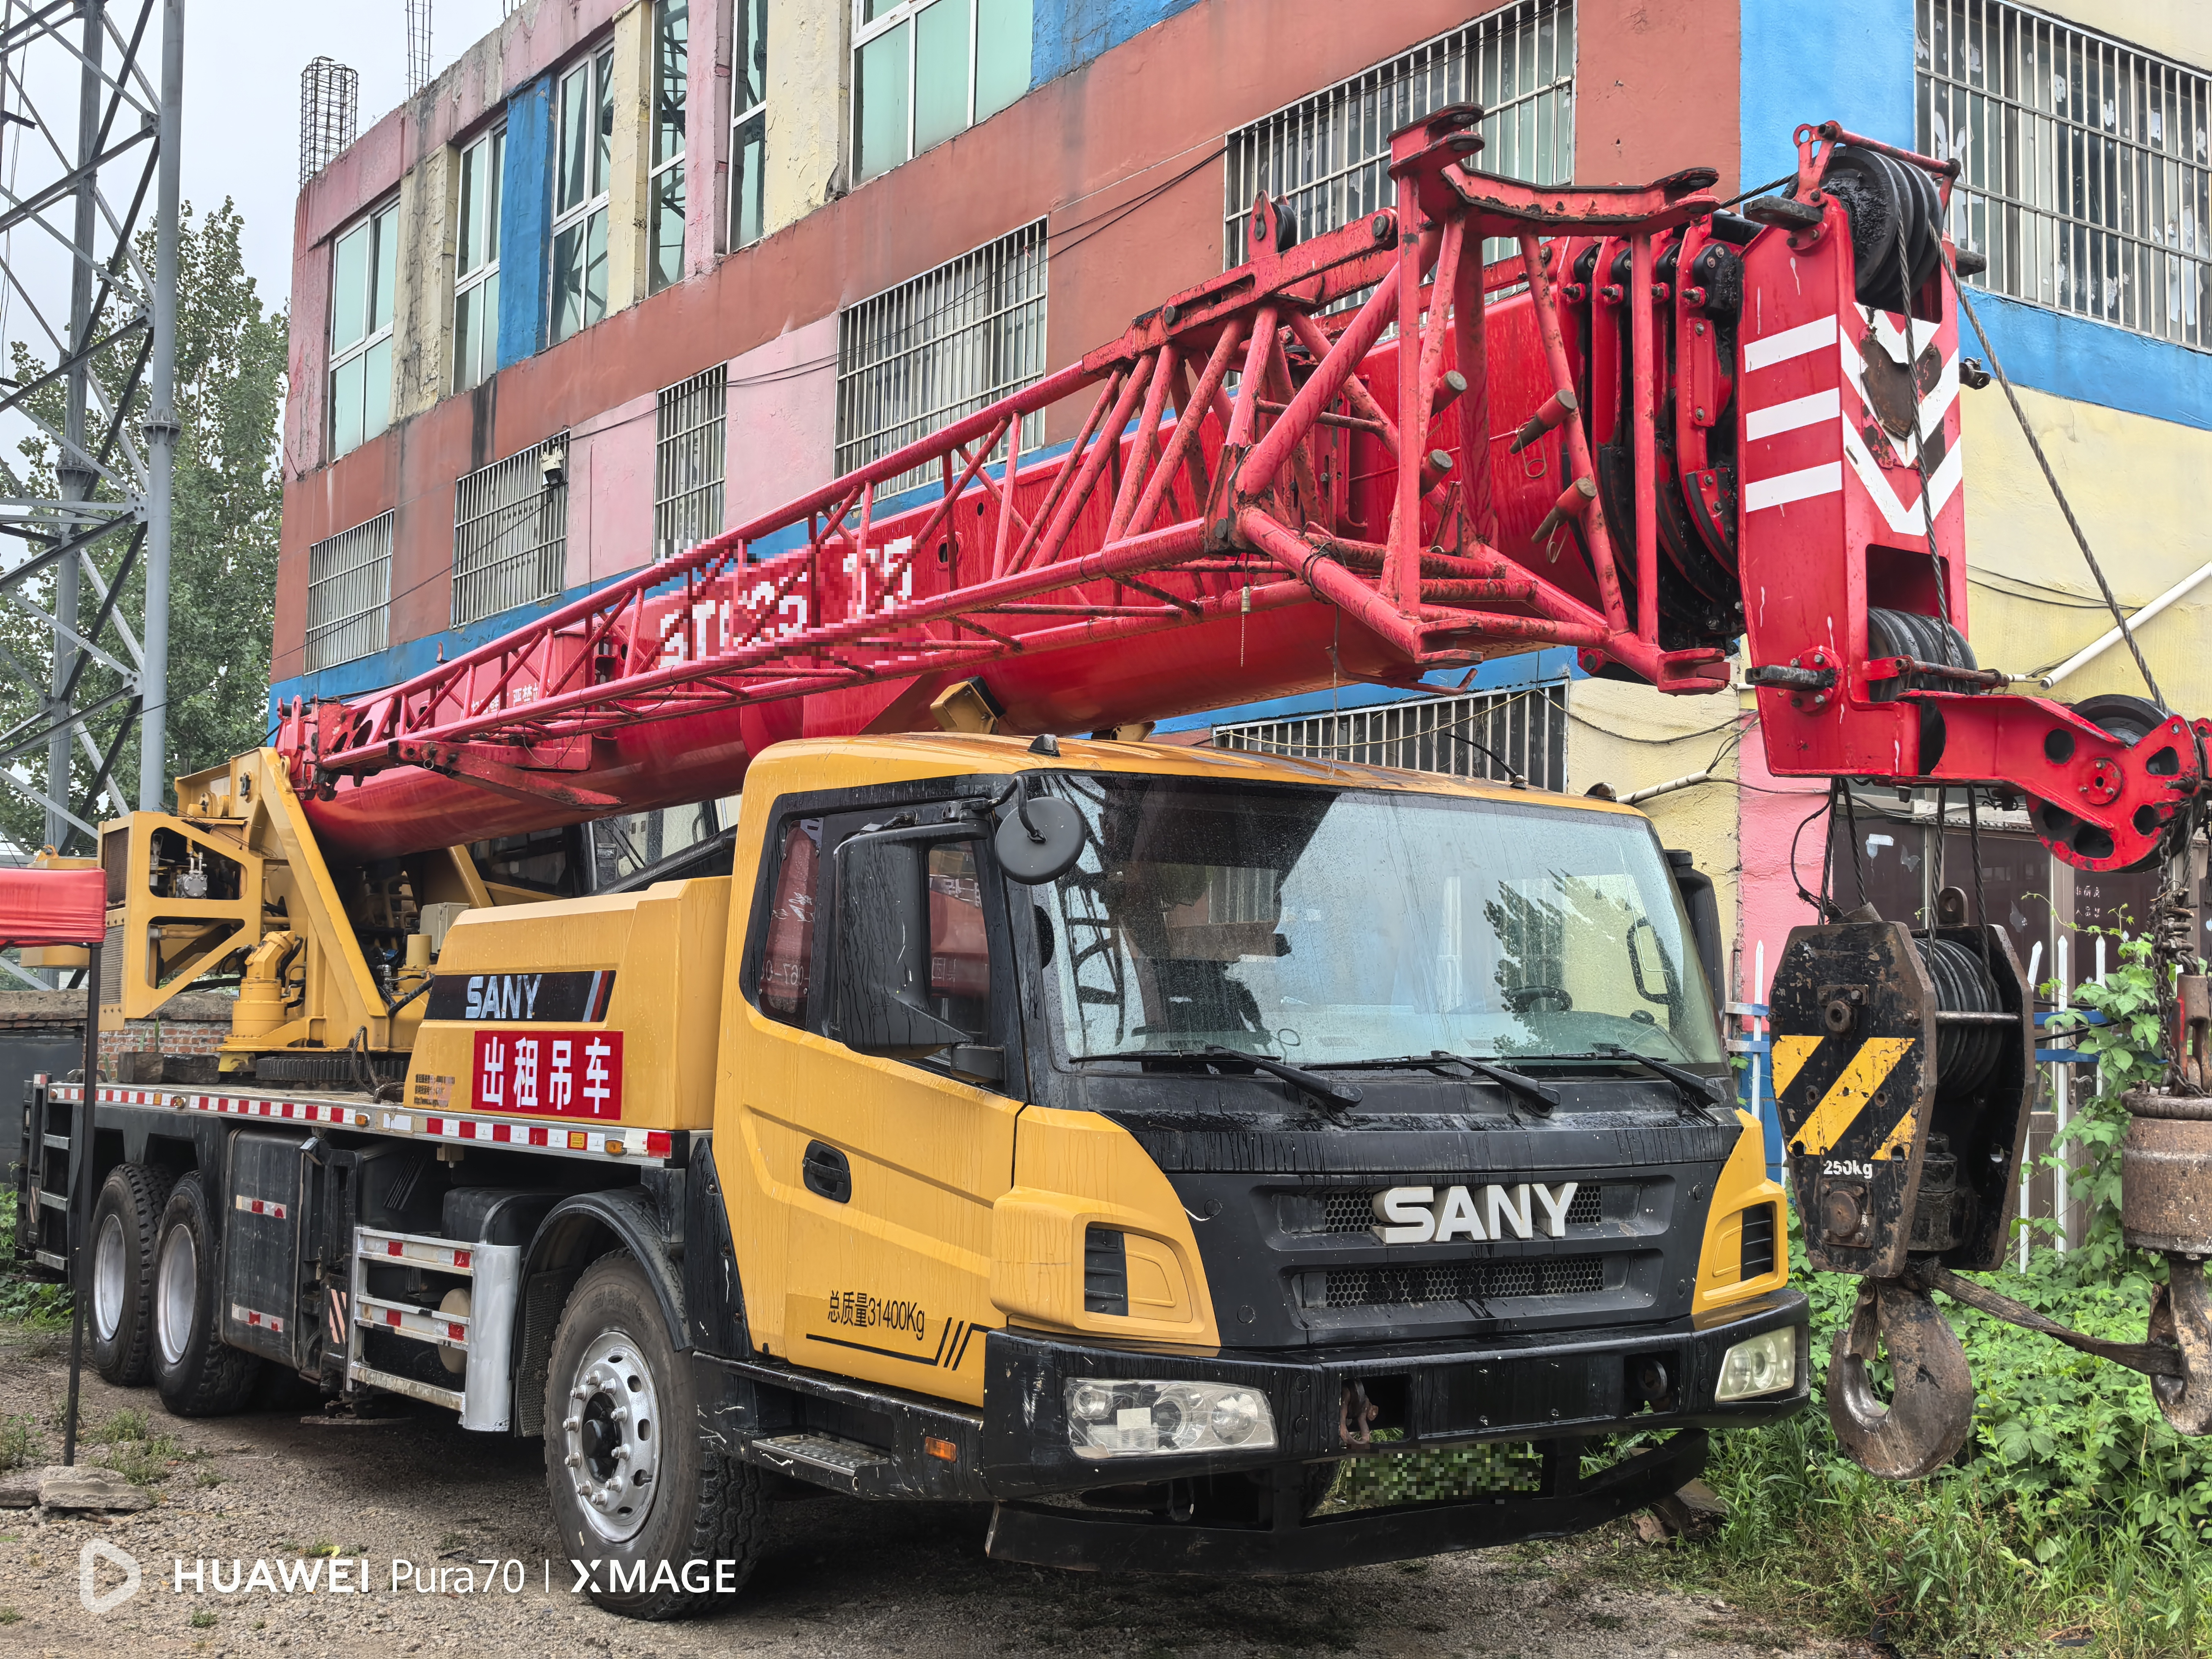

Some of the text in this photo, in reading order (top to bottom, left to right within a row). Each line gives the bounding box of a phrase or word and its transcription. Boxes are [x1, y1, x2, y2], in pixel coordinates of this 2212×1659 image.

[465, 975, 542, 1019] SANY
[482, 1036, 611, 1114] 出租吊车
[1823, 1160, 1873, 1179] 250kg
[1379, 1182, 1578, 1244] SANY
[828, 1289, 925, 1341] 总质量31400Kg
